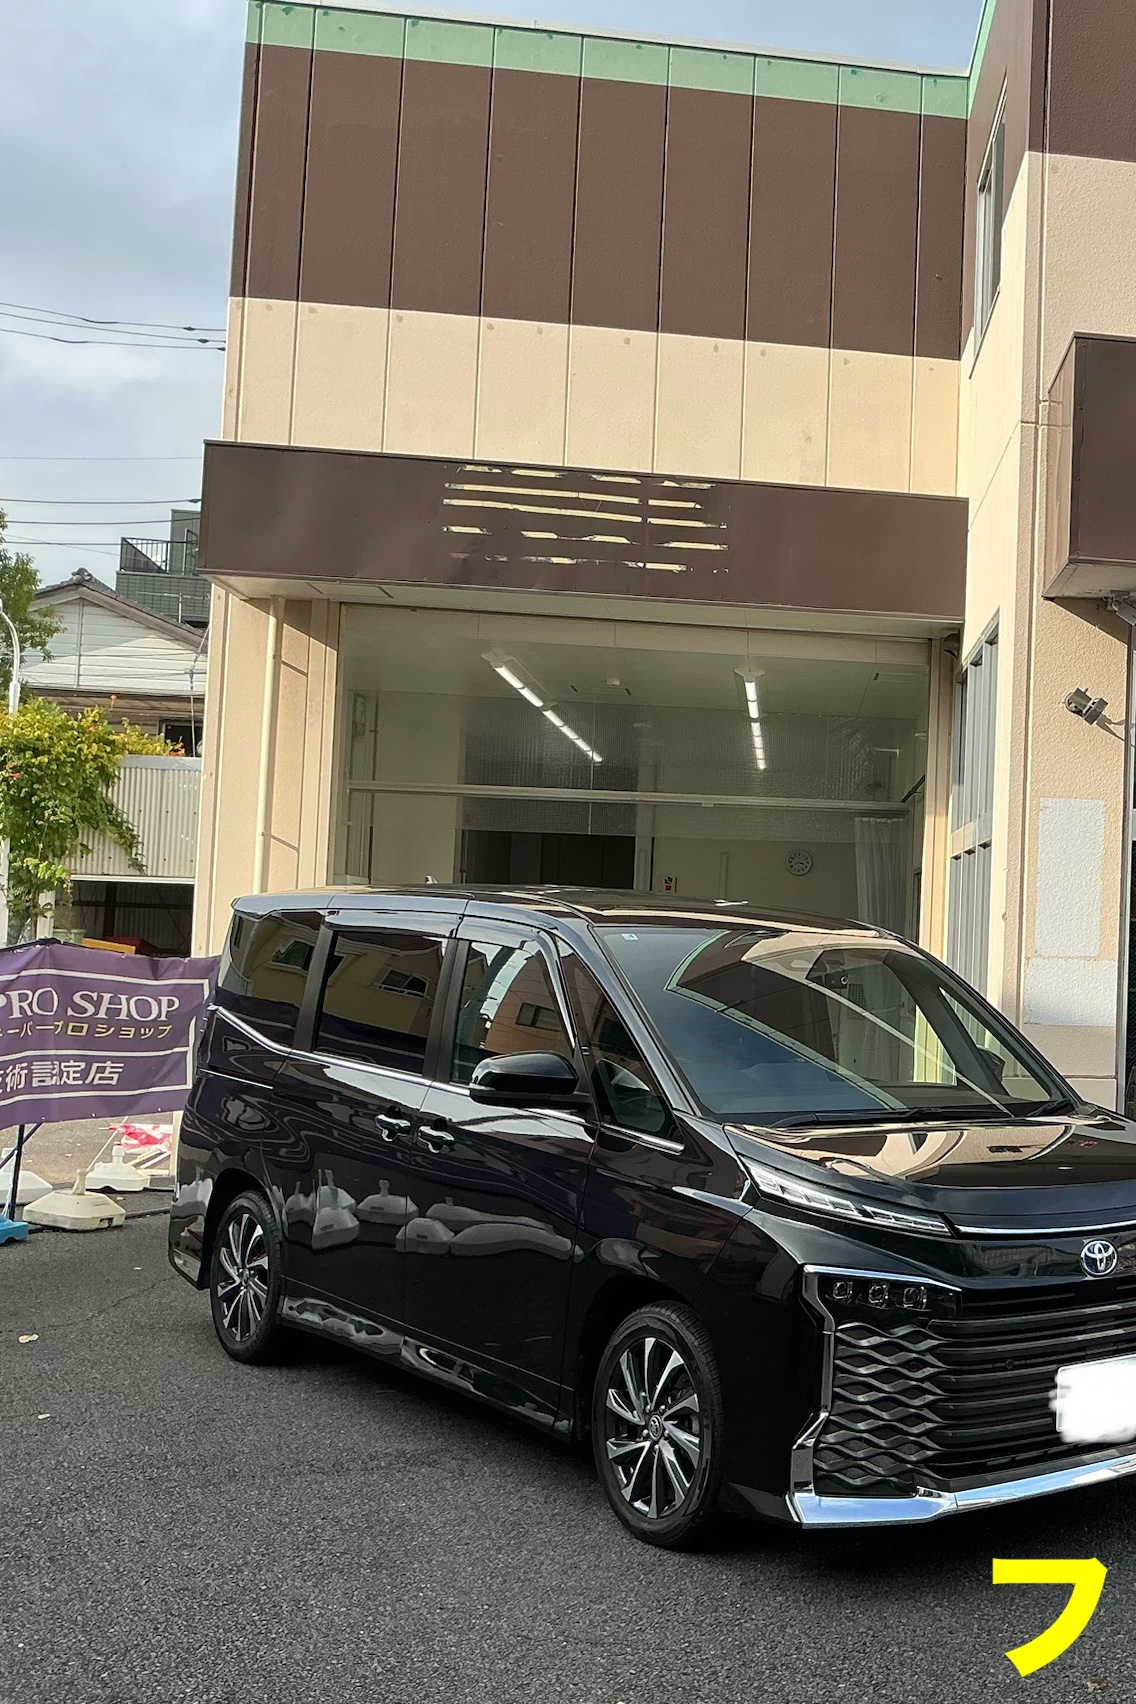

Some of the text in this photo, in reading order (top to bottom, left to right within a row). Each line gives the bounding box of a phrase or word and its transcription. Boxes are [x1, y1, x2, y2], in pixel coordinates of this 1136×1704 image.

[67, 990, 180, 1021] SHOP
[0, 1020, 173, 1039] ーパープロショップ
